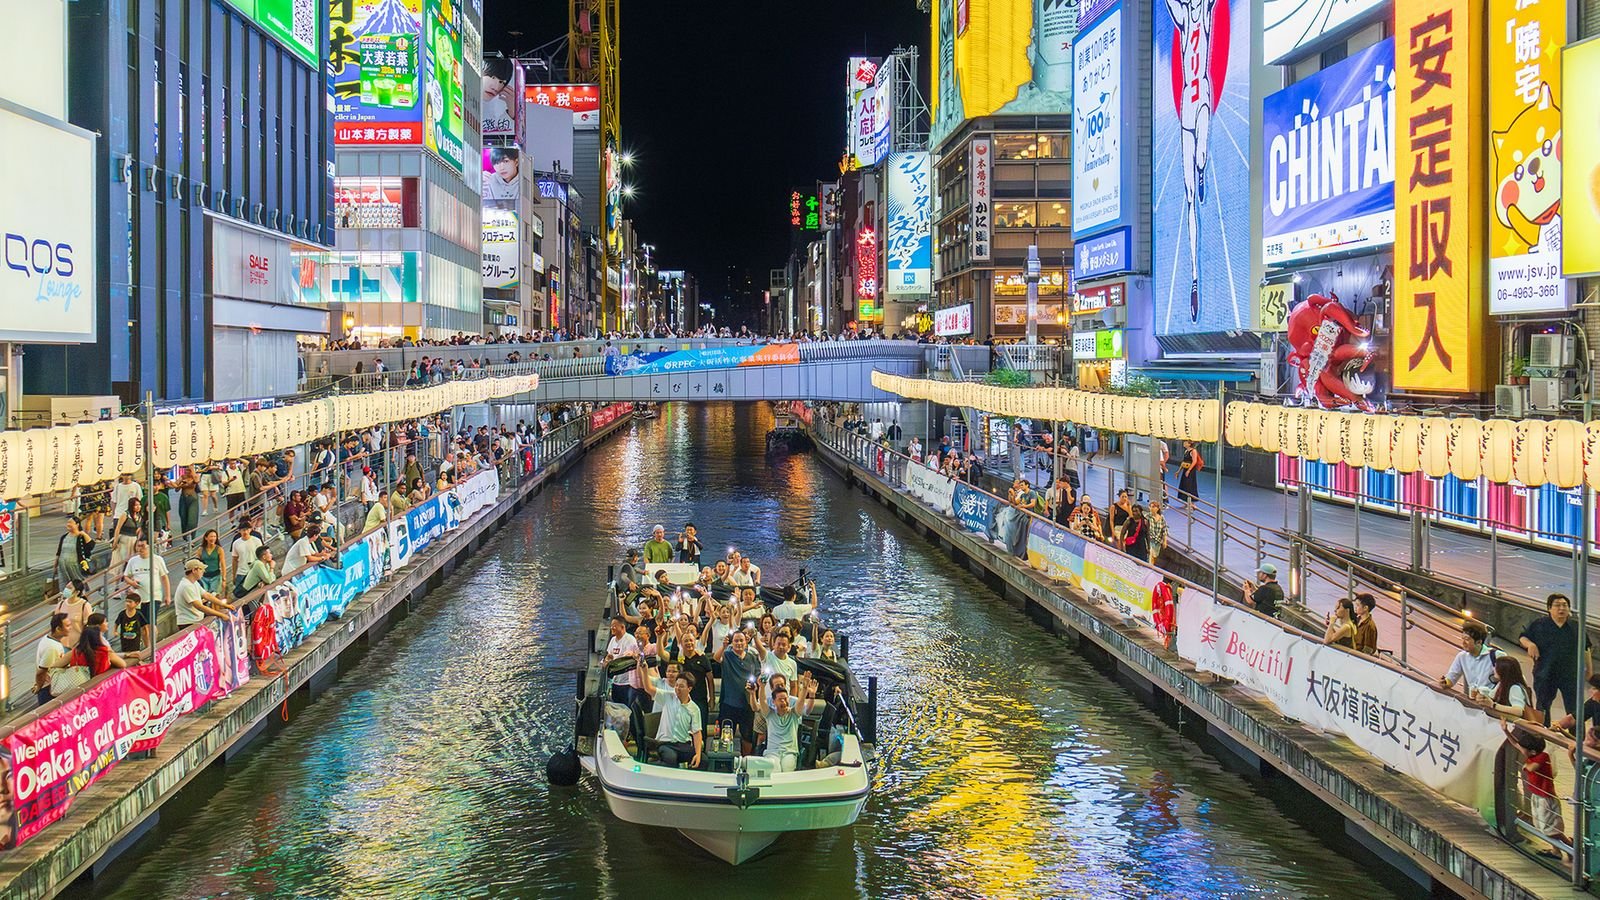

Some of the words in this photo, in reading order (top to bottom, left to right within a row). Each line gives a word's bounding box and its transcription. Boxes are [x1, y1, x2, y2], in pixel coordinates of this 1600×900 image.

[362, 50, 409, 66] 大麦若葉
[1190, 24, 1202, 103] グリコ
[339, 128, 412, 140] 山本漢方製薬
[1269, 66, 1396, 217] CHINTAI
[1409, 8, 1453, 374] 安定収入
[805, 196, 819, 226] 千房
[249, 254, 268, 271] SALE
[1498, 262, 1558, 281] www.jsv.jp
[36, 265, 82, 312] Lounge
[1497, 284, 1559, 300] 06-4963-3661
[653, 383, 724, 394] えびす橋
[169, 422, 177, 461] PABLO
[1201, 616, 1222, 650] 美
[62, 724, 73, 737] to
[72, 706, 99, 731] Osaka
[1305, 669, 1461, 773] 大阪樟蔭女子大学
[16, 748, 74, 800] Osaka
[77, 732, 91, 766] is
[94, 718, 115, 750] our
[73, 769, 90, 791] NO
